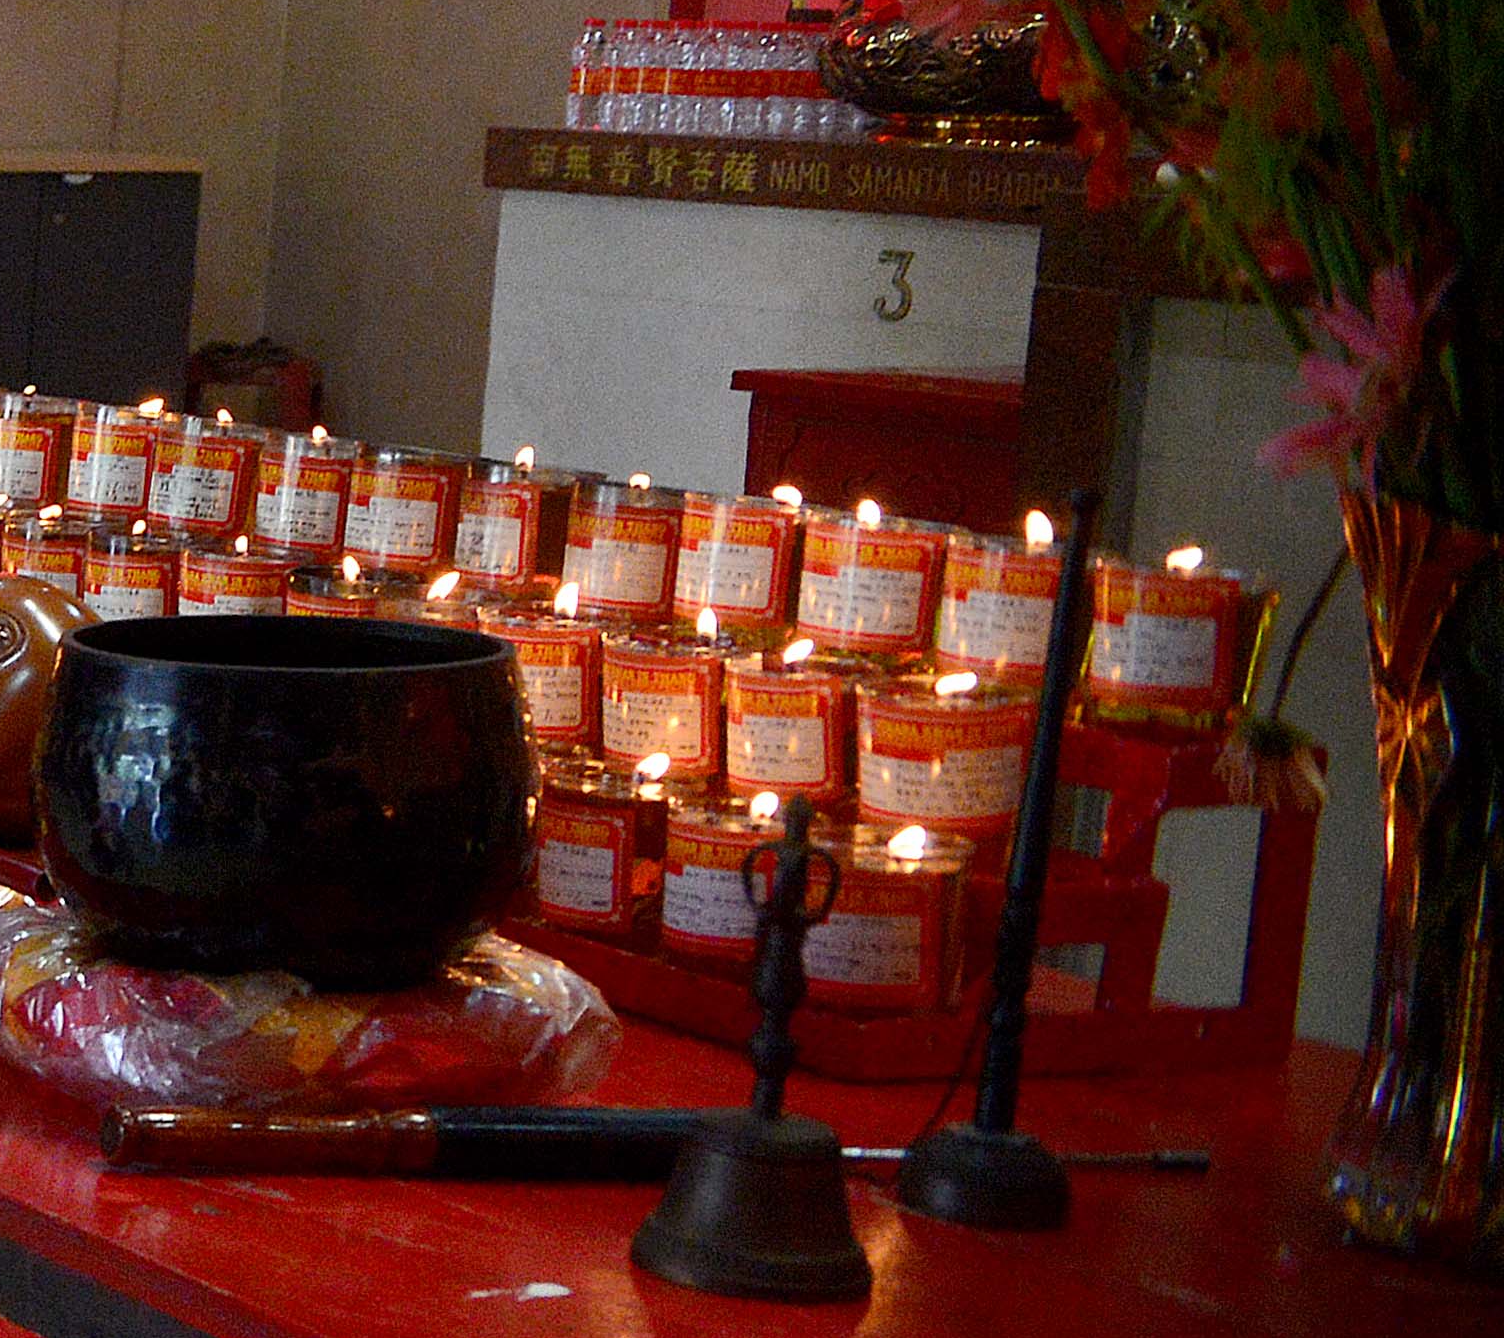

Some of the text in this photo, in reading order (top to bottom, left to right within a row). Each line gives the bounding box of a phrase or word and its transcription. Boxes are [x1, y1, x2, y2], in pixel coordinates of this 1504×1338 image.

[768, 159, 831, 195] NAMO
[847, 163, 949, 201] SAMANTA
[873, 248, 915, 323] 3
